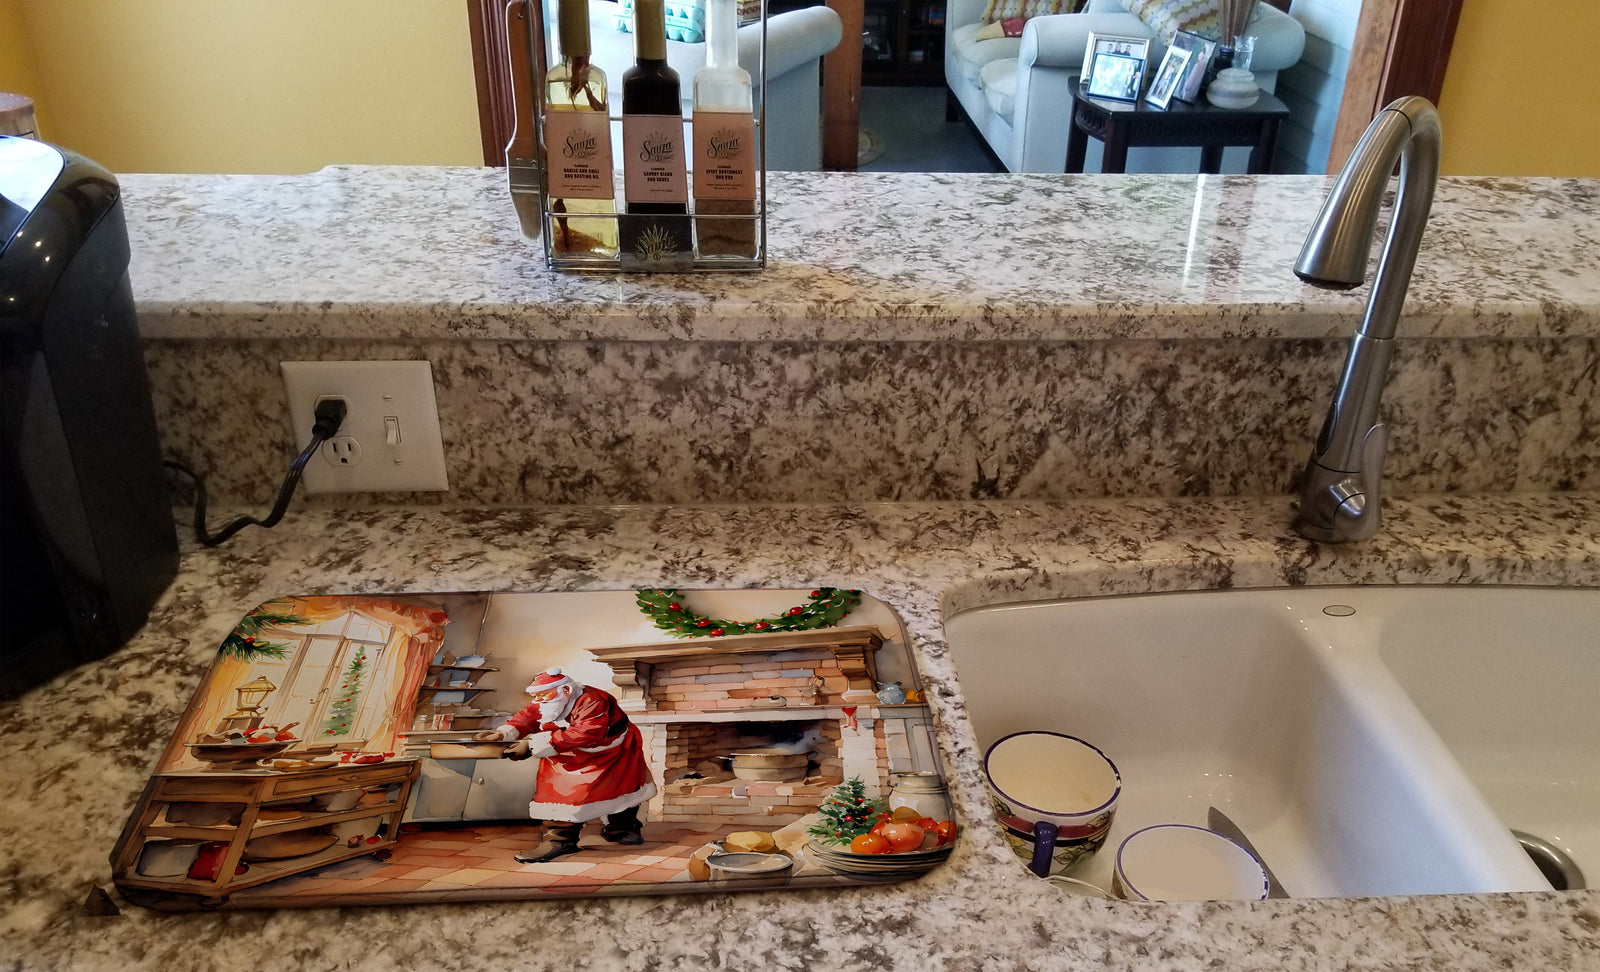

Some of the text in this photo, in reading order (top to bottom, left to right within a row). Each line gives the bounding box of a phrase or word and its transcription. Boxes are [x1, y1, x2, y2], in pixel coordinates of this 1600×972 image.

[562, 136, 597, 158] Sauza
[639, 140, 673, 162] Sauza
[706, 137, 740, 159] Sauza
